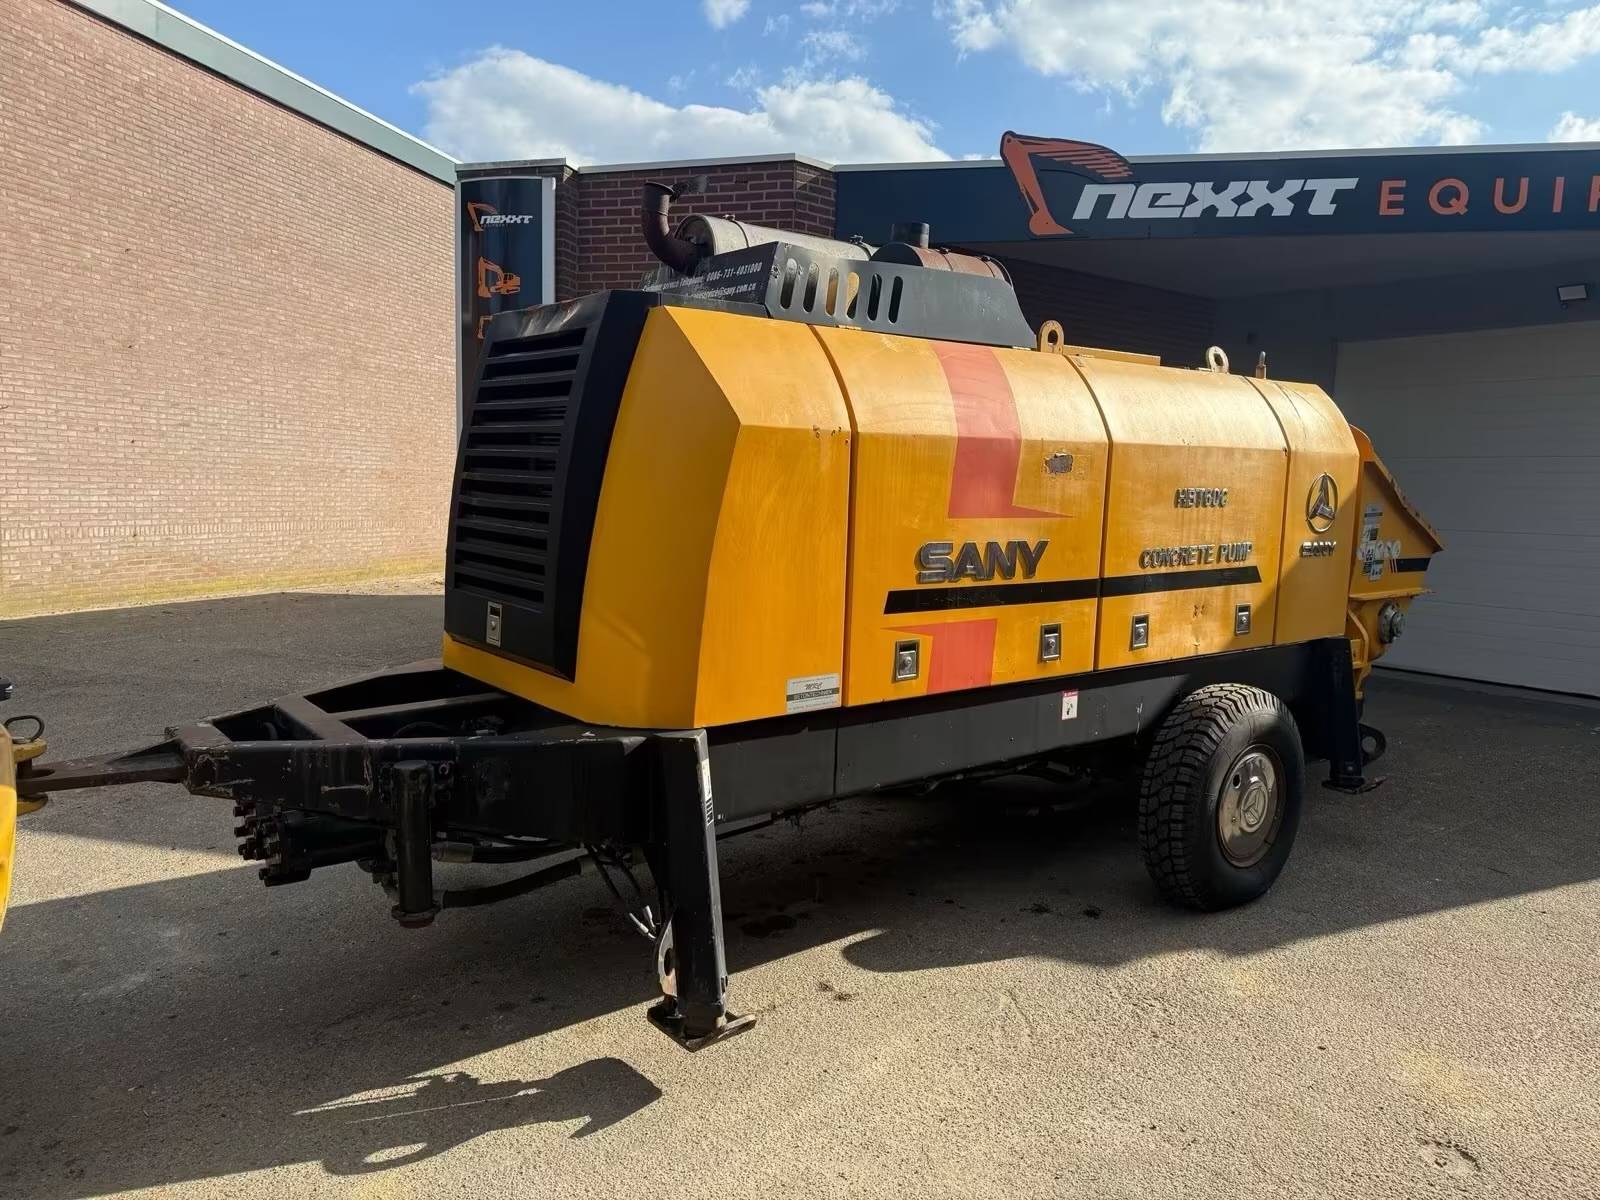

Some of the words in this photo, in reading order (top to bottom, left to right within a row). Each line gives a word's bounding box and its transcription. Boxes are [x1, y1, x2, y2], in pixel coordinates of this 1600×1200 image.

[914, 539, 1050, 585] SANY
[1139, 544, 1215, 570] CONCRETE
[1217, 541, 1253, 564] PUMP
[1301, 541, 1336, 558] SANY
